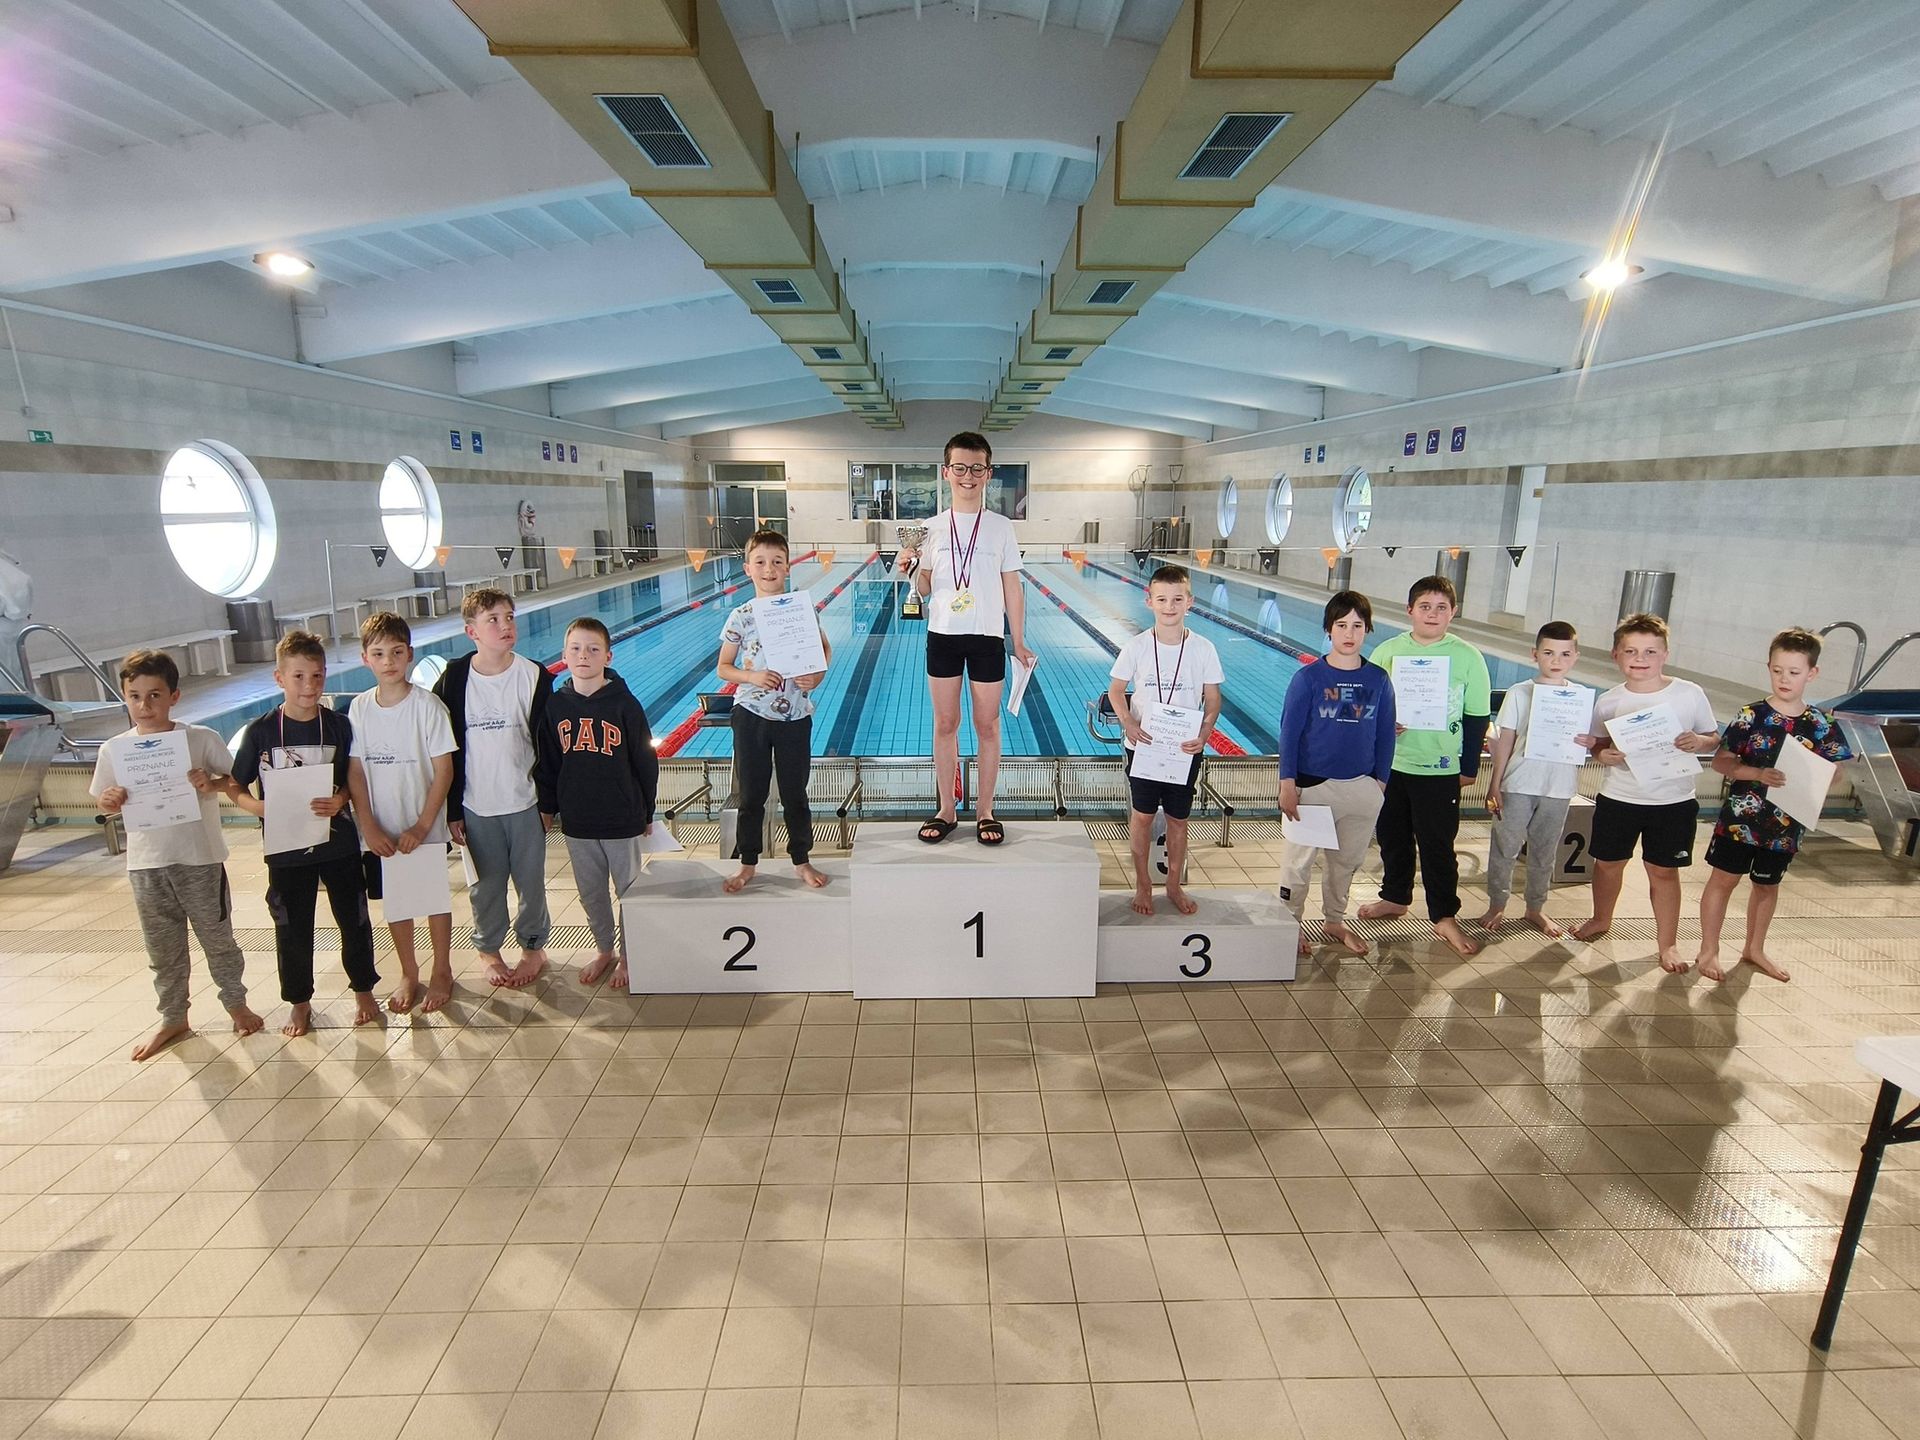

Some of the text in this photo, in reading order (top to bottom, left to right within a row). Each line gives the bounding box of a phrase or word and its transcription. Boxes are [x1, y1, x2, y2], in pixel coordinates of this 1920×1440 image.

[557, 717, 622, 756] GAP
[127, 759, 176, 773] PRIZNANJE
[1564, 832, 1585, 873] 2
[722, 926, 758, 971] 2
[963, 911, 984, 959] 1
[1179, 933, 1213, 978] 3
